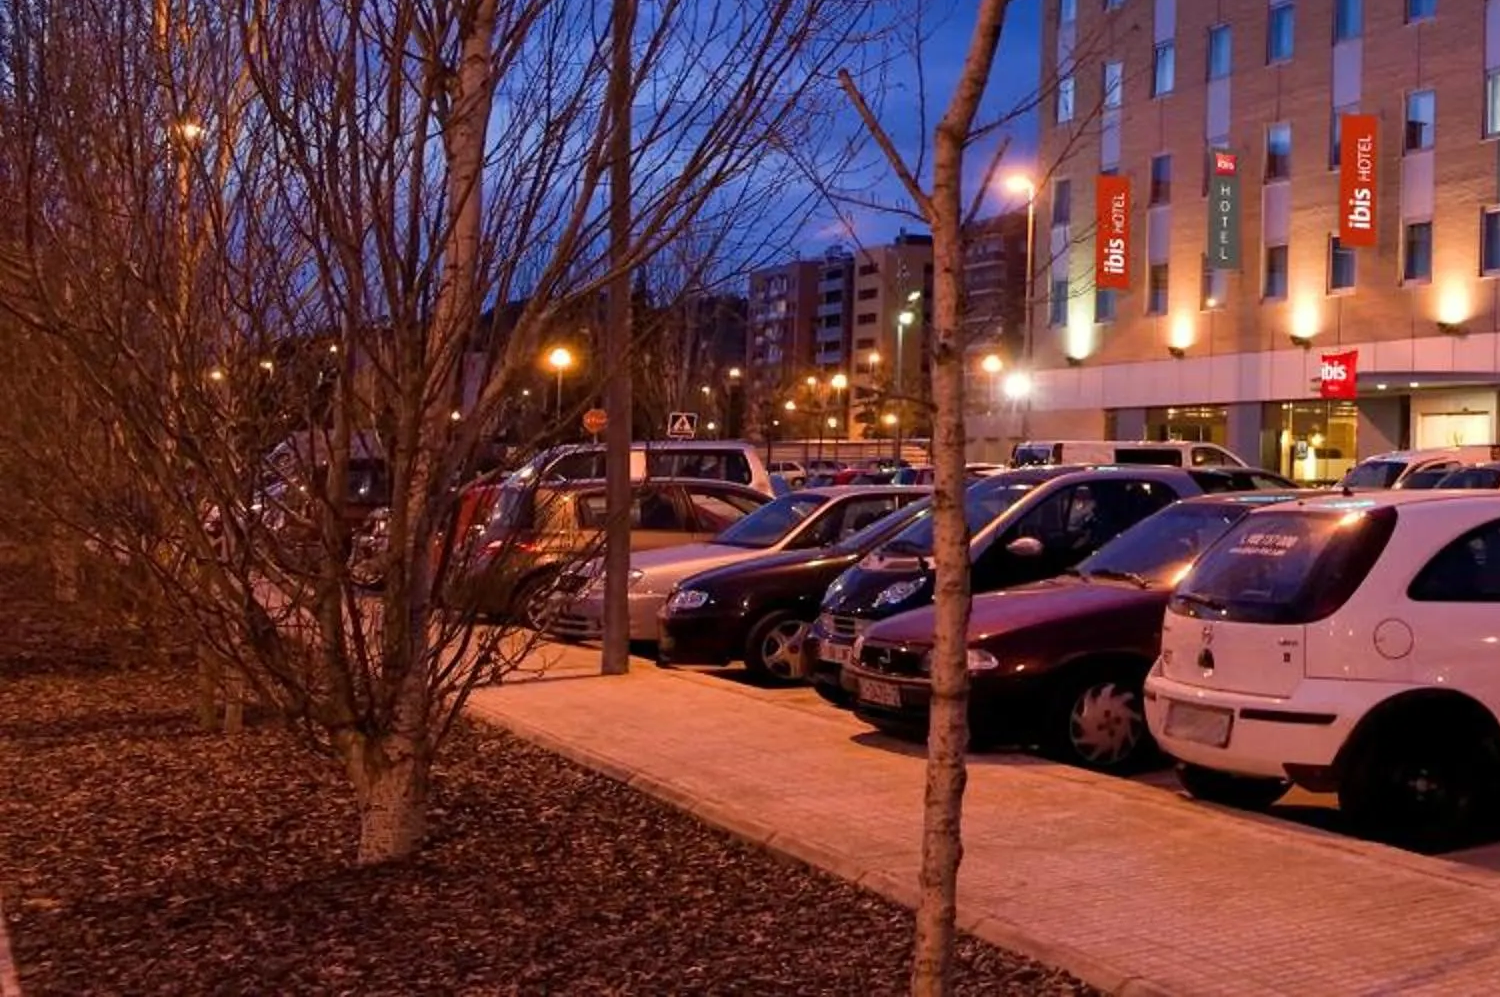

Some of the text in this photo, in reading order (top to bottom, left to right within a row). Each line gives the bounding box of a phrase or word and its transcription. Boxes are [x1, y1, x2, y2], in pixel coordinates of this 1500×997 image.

[1348, 133, 1372, 229] ibis HOTEL
[1104, 193, 1125, 274] ibis HOTEL
[1220, 184, 1231, 260] HOTEL
[1321, 360, 1347, 380] ibis
